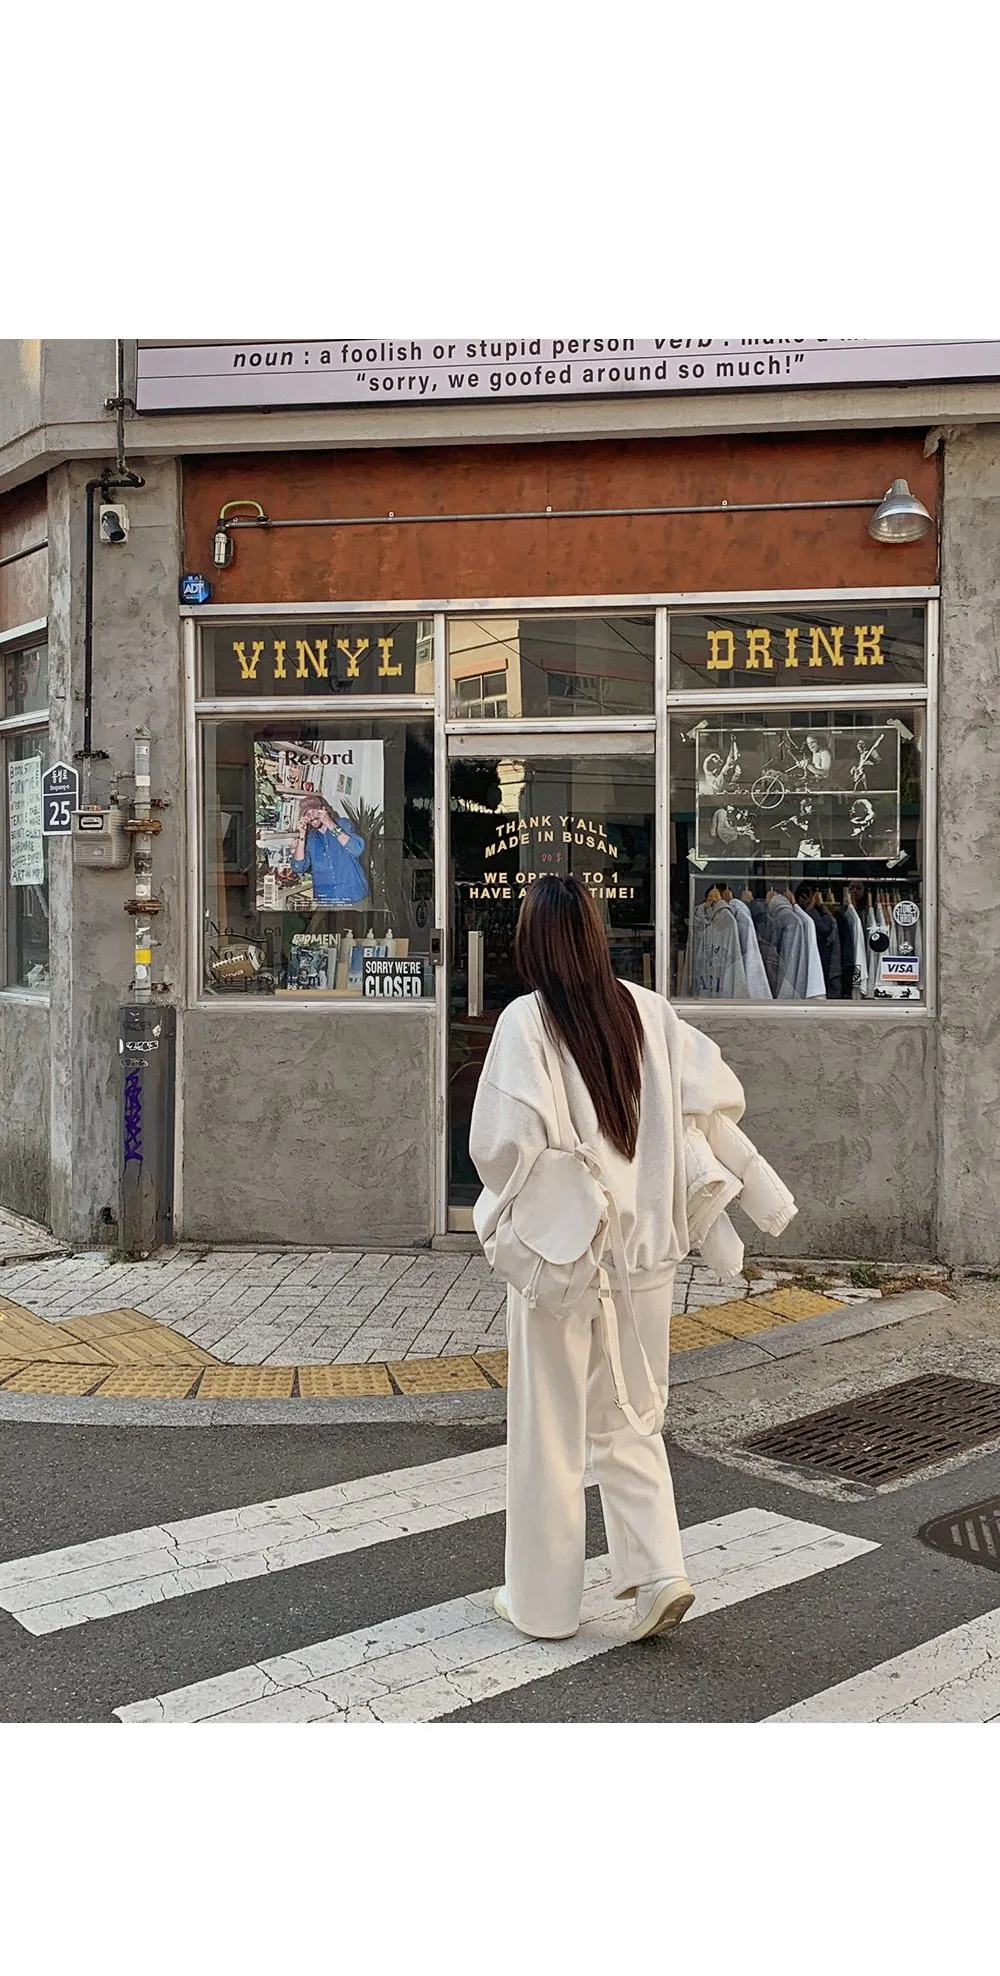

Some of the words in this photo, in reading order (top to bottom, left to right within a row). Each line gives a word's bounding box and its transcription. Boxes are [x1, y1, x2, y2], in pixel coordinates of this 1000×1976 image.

[233, 349, 293, 368] noun
[320, 350, 331, 364] a
[341, 342, 422, 363] foolish
[433, 343, 456, 359] or
[466, 339, 540, 361] stupid
[552, 339, 634, 359] person
[448, 373, 479, 388] we
[489, 364, 571, 392] goofed
[582, 361, 667, 383] around
[678, 364, 704, 380] so
[233, 638, 402, 679] VINYL
[706, 625, 884, 670] DRINK
[285, 750, 353, 766] Record
[49, 801, 71, 826] 25
[496, 815, 551, 838] THANK
[559, 816, 608, 838] Y'ALL
[485, 832, 530, 859] MADE
[537, 831, 554, 842] IN
[562, 831, 618, 859] BUSAN
[484, 873, 507, 883] WE
[582, 872, 604, 884] TO
[611, 873, 618, 883] 1
[469, 888, 511, 899] HAVE
[589, 887, 634, 899] TIME!
[365, 961, 394, 974] SORRY
[395, 961, 421, 974] WE'RE
[887, 963, 914, 974] VISA
[365, 975, 421, 998] CLOSED
